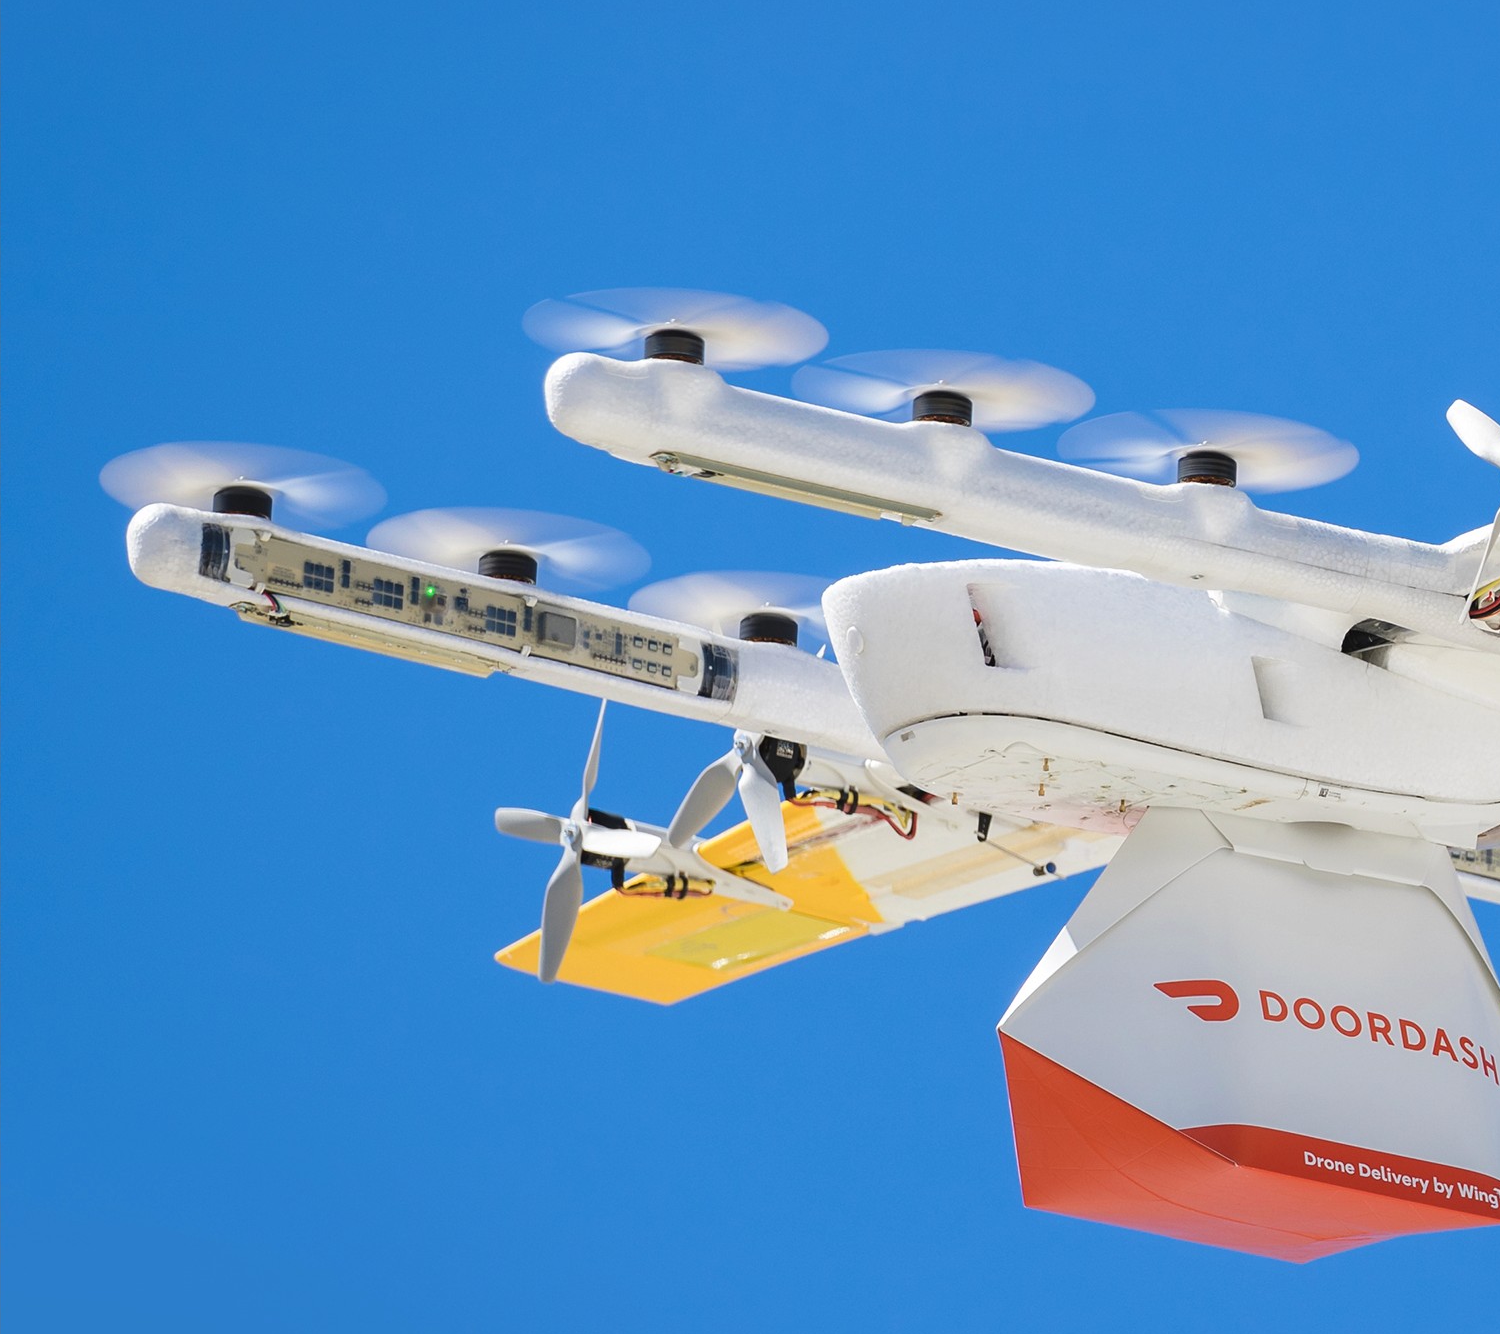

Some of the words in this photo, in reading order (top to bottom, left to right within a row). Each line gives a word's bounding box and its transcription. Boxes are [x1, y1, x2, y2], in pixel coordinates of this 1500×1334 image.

[1259, 989, 1500, 1086] DOORDASH
[1303, 1151, 1355, 1175] Drone
[1359, 1162, 1430, 1194] Delivery
[1433, 1176, 1454, 1199] by
[1457, 1182, 1500, 1209] Wing
